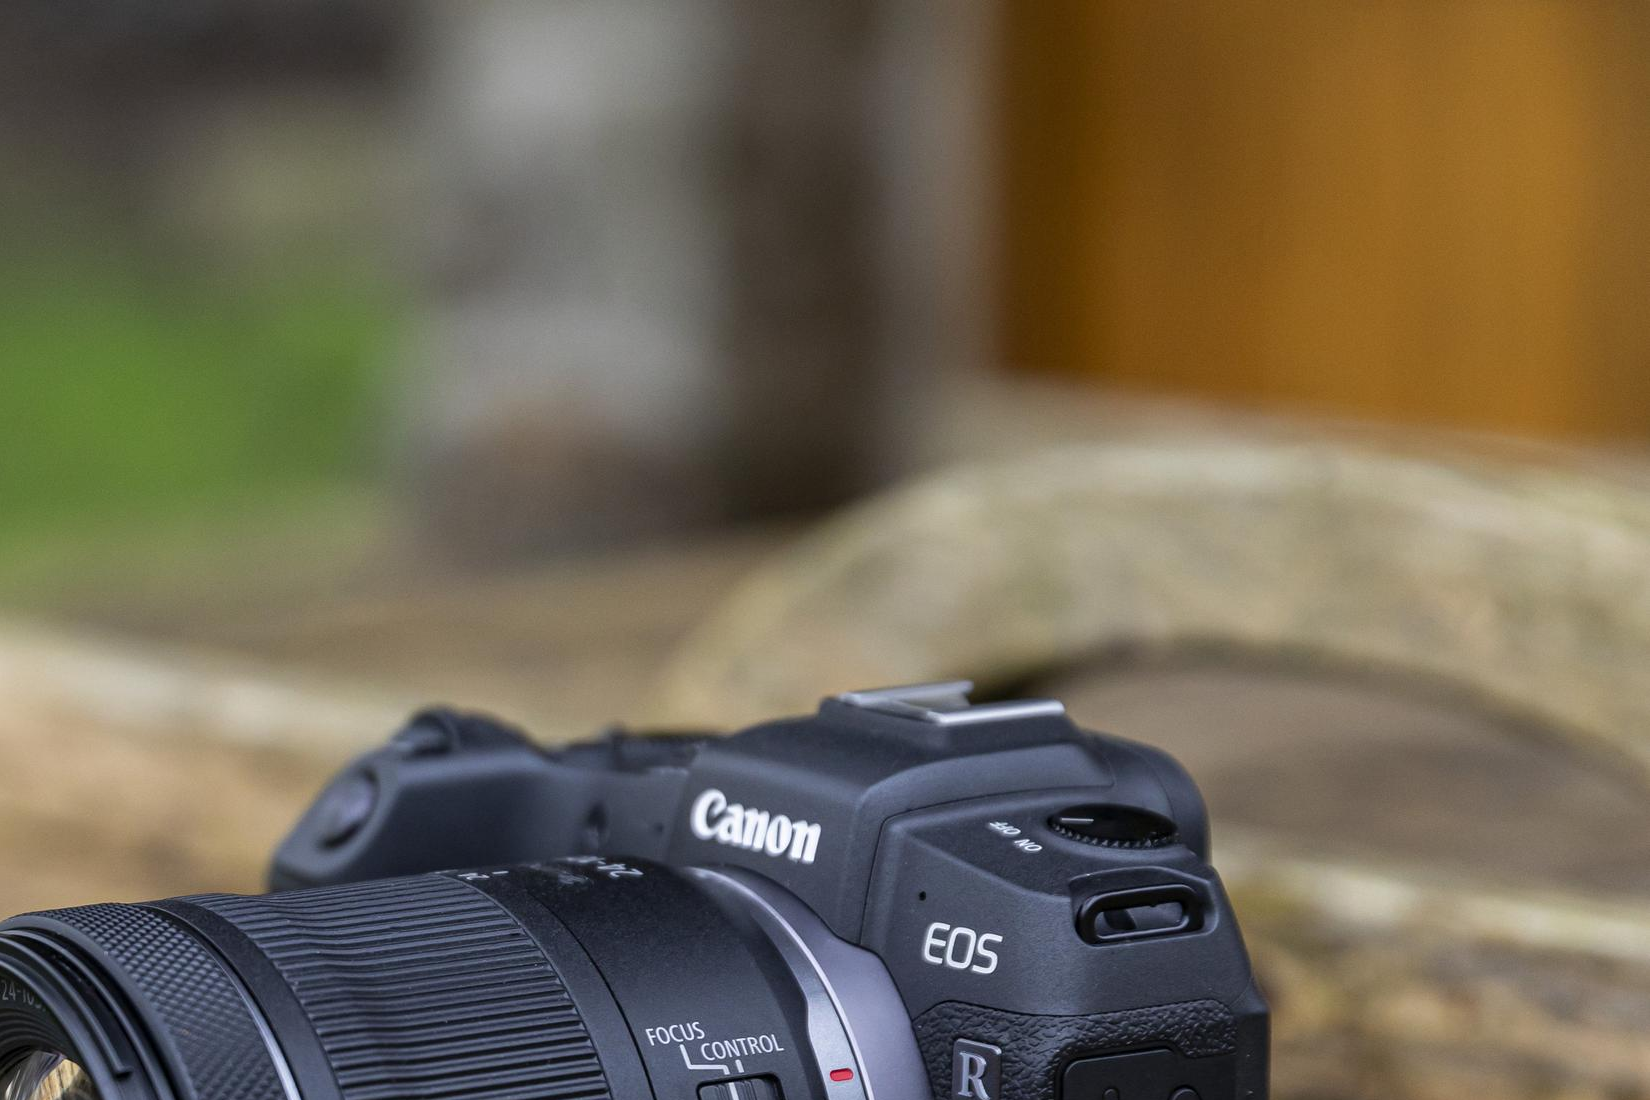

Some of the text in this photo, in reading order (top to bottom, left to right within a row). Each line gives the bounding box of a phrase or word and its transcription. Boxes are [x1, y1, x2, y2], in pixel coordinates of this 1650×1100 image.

[690, 788, 821, 864] Canon
[989, 821, 1043, 852] ON OFF
[923, 922, 1003, 974] EOS
[645, 1021, 705, 1046] FOCUS
[700, 1033, 784, 1061] CONTROL
